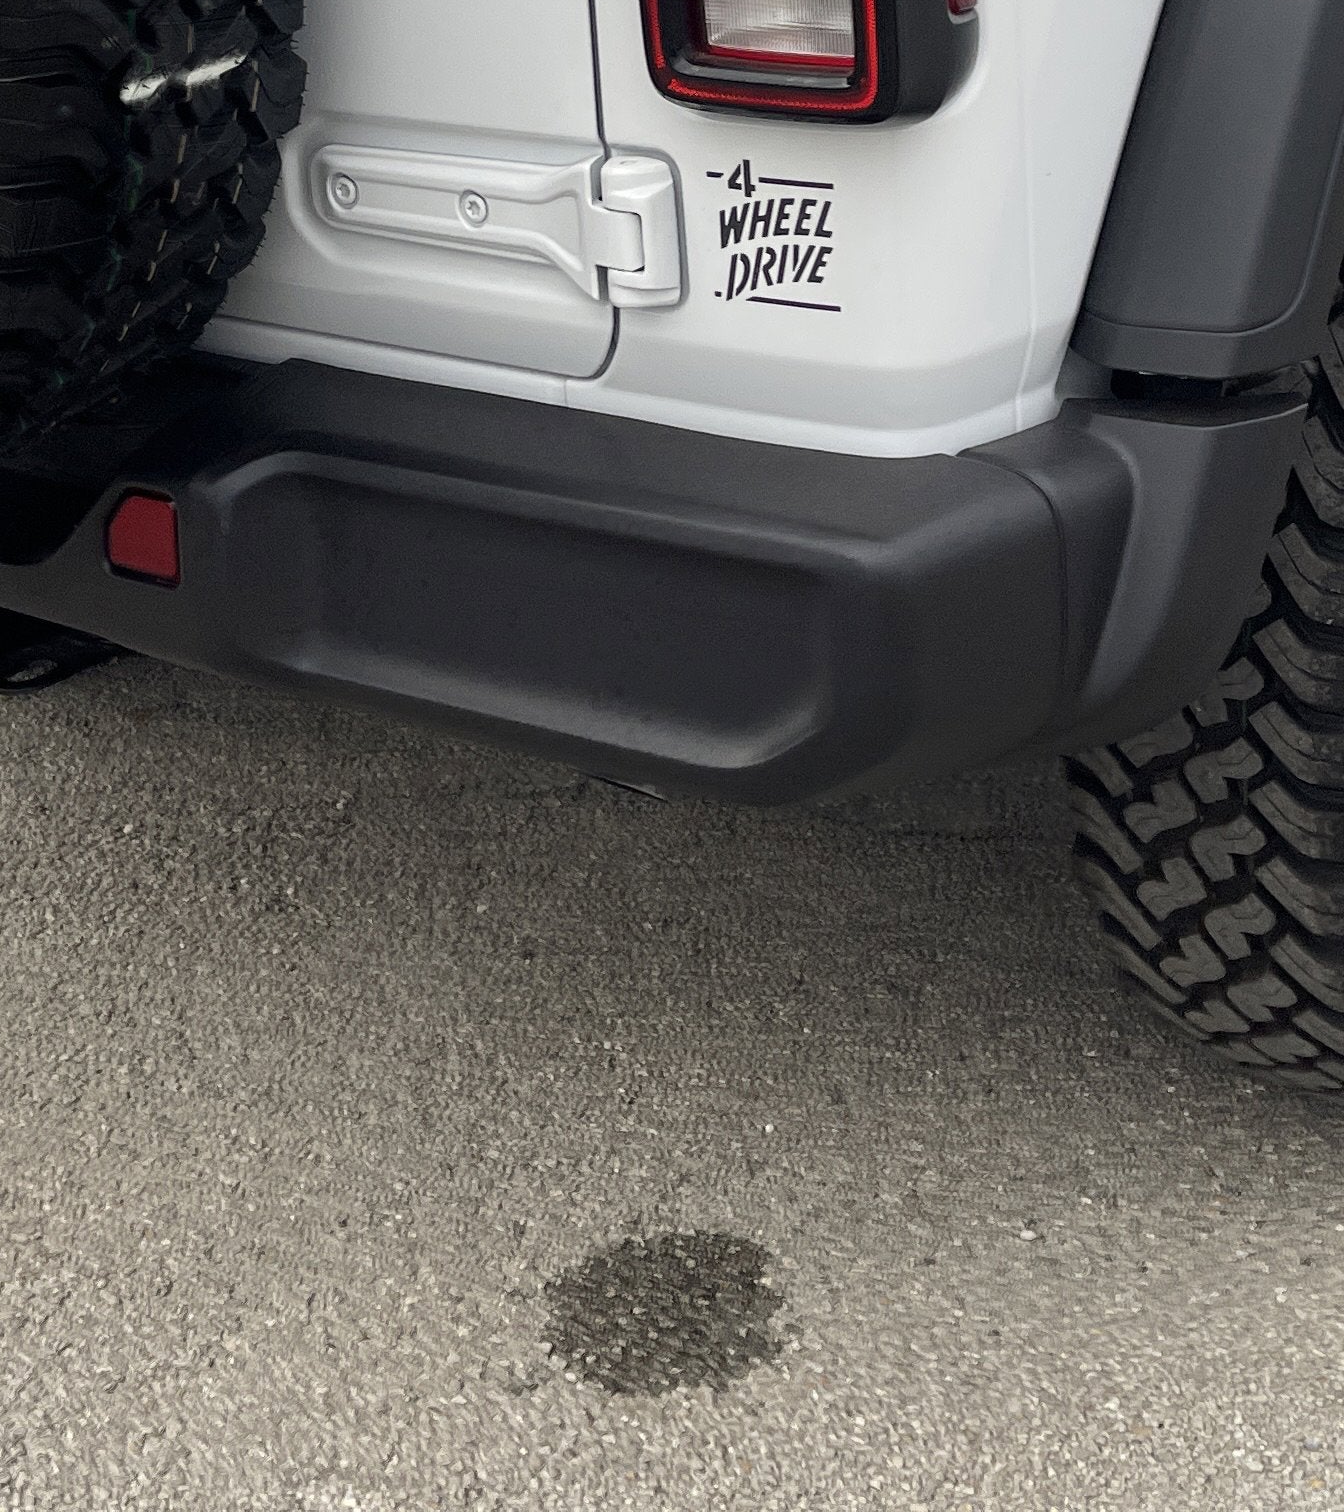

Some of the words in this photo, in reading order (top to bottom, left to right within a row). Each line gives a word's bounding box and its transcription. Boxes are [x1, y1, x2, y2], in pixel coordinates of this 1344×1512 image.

[727, 159, 756, 198] 4
[719, 198, 833, 249] WHEEL
[725, 244, 834, 301] DRIVE
